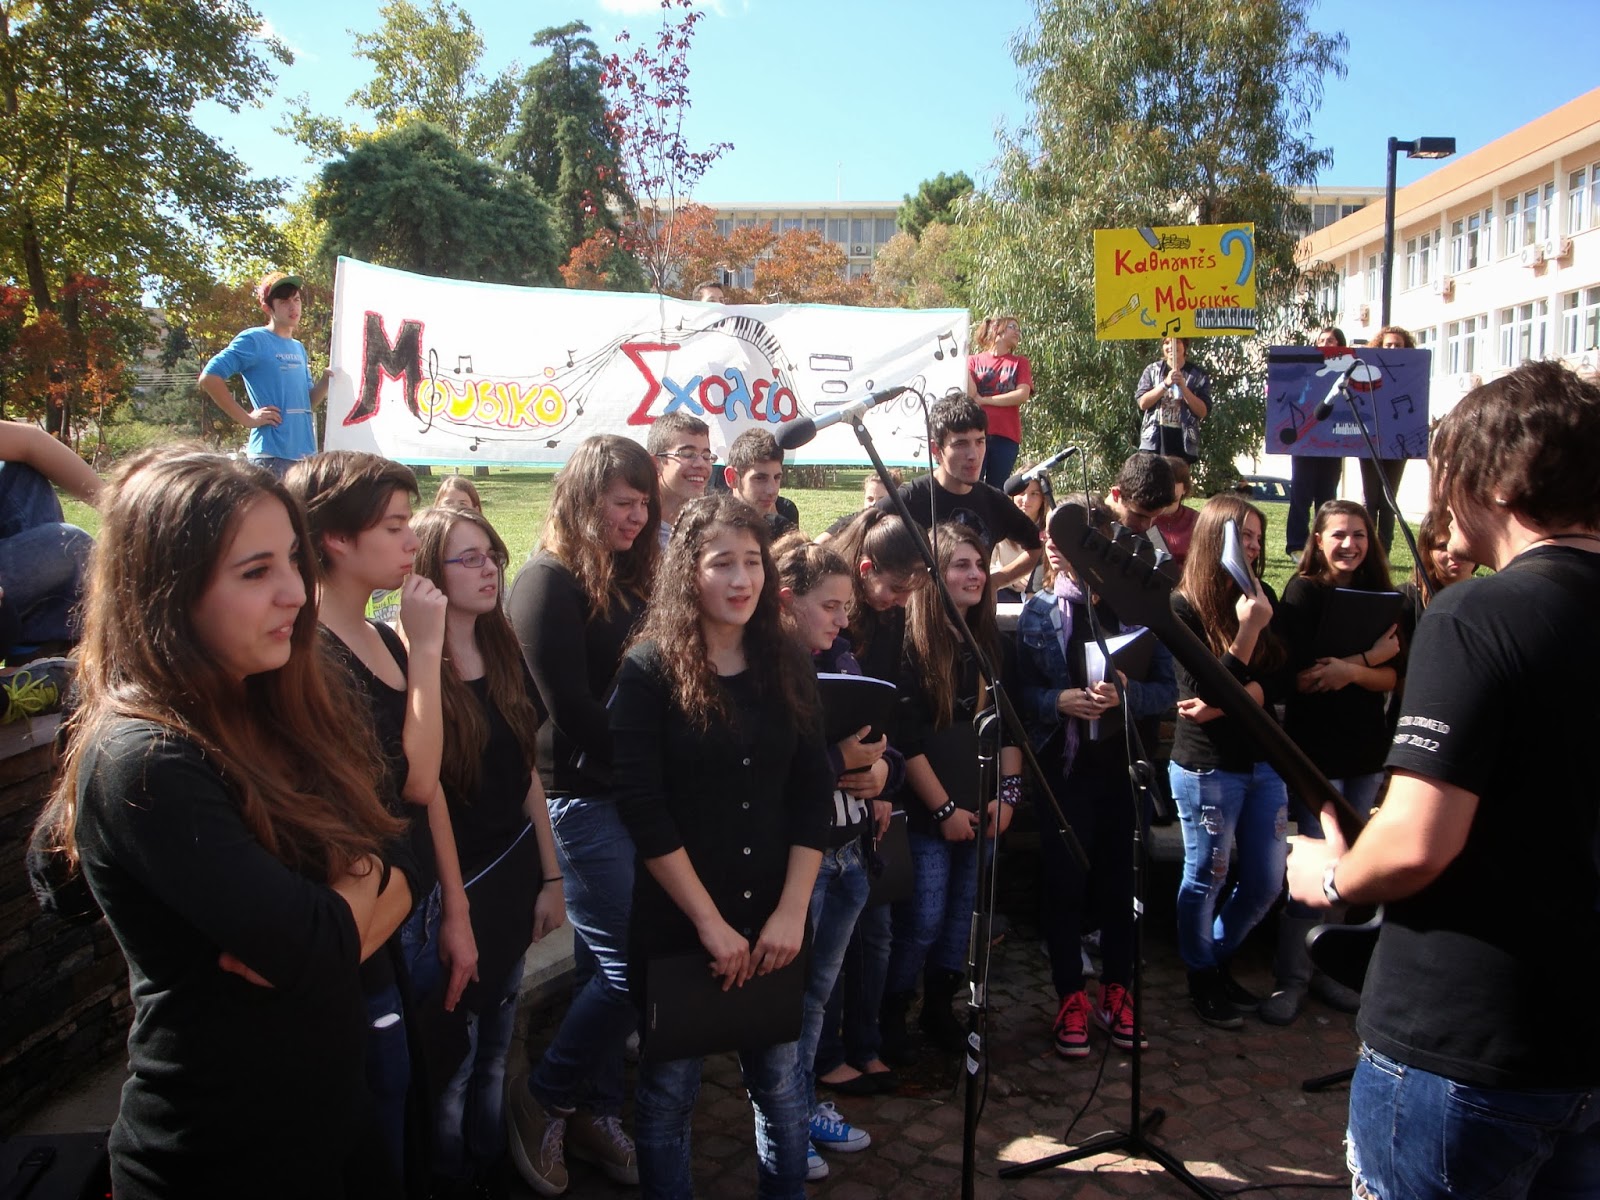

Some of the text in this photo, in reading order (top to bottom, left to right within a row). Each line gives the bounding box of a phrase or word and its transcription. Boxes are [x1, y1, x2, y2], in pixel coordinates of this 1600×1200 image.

[1115, 248, 1217, 276] Καθηγητές
[1155, 275, 1240, 313] Μουσικής
[343, 310, 567, 428] Μουσικό
[620, 341, 798, 425] Σχολείο
